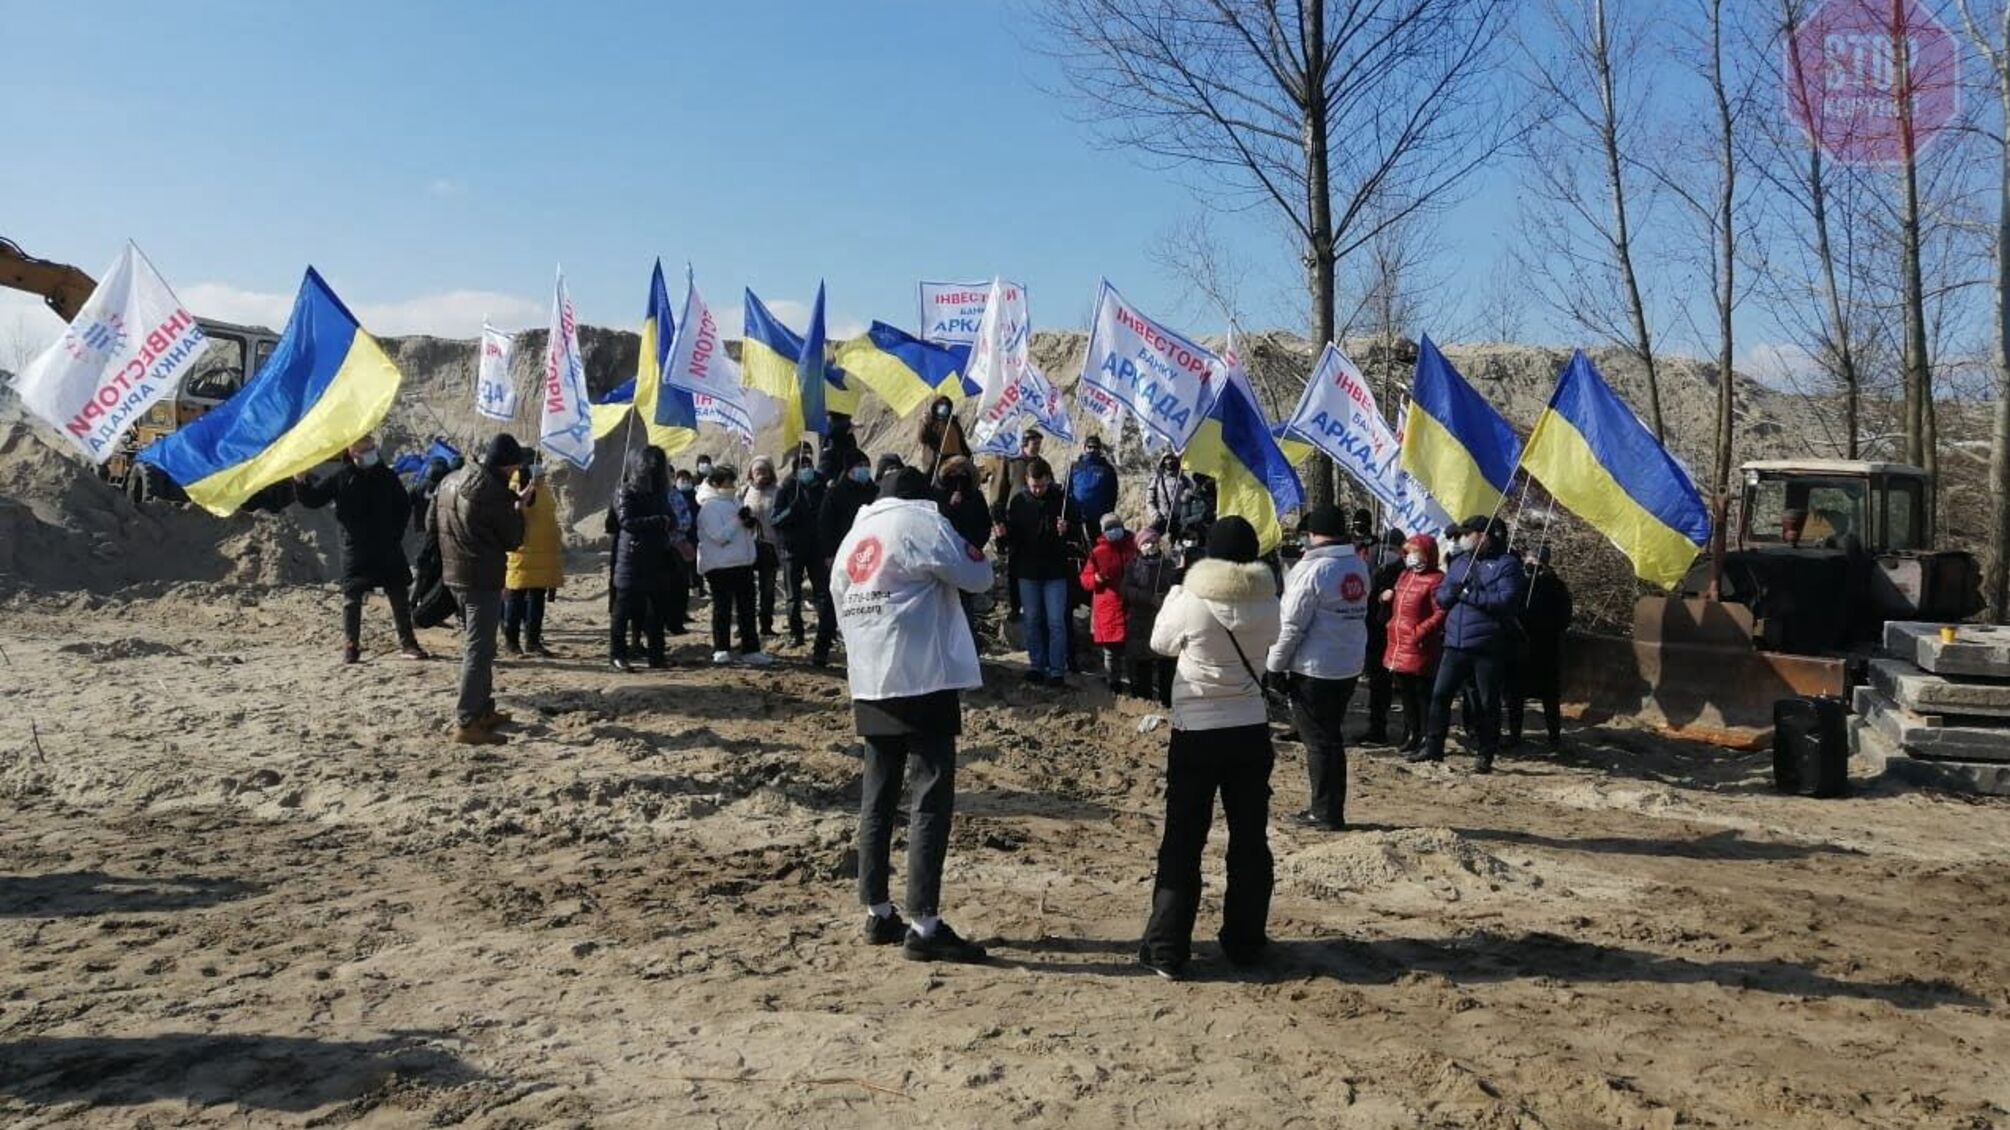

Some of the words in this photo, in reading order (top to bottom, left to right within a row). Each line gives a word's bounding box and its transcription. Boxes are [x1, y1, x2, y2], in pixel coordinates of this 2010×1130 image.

[1117, 307, 1212, 384] ІНВЕСТОРИ
[1138, 347, 1178, 379] БАНКУ
[1102, 351, 1191, 430] АРКАДА
